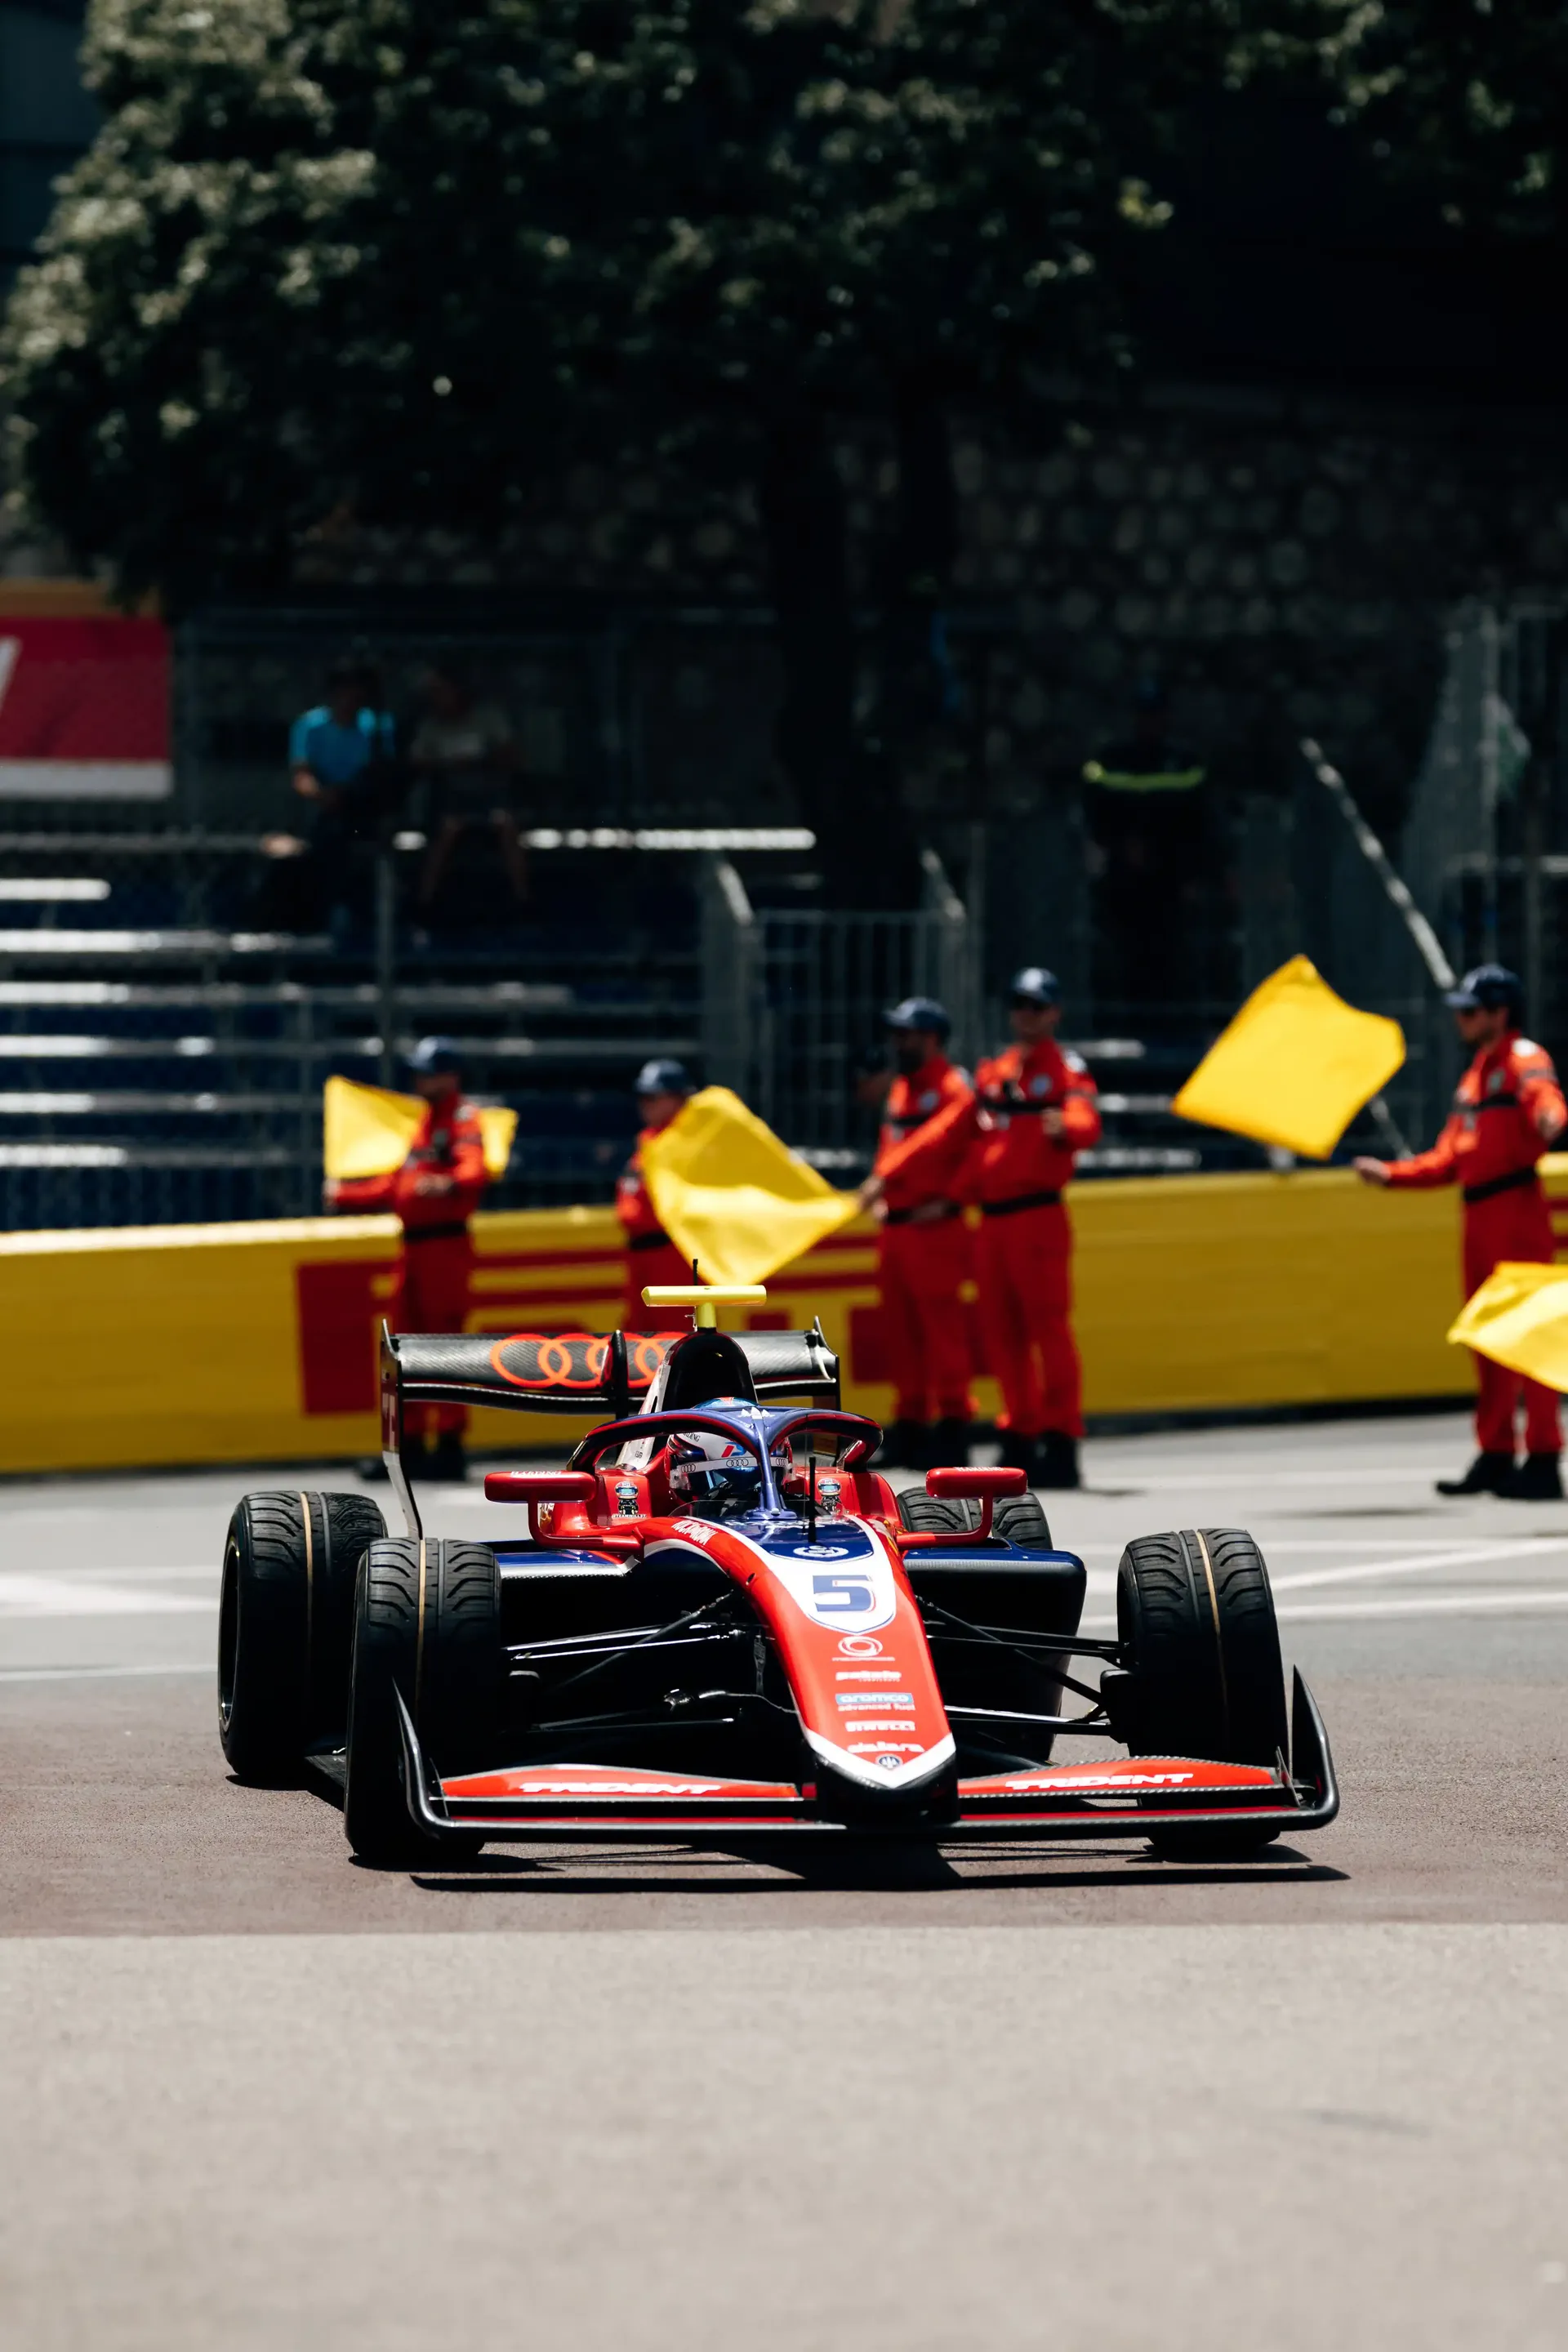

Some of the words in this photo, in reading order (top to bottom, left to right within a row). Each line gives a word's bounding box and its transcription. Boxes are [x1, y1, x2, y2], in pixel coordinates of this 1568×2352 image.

[813, 1575, 875, 1613] 5
[519, 1782, 721, 1794] TRIDENT
[1005, 1773, 1193, 1790] TRIDENT
